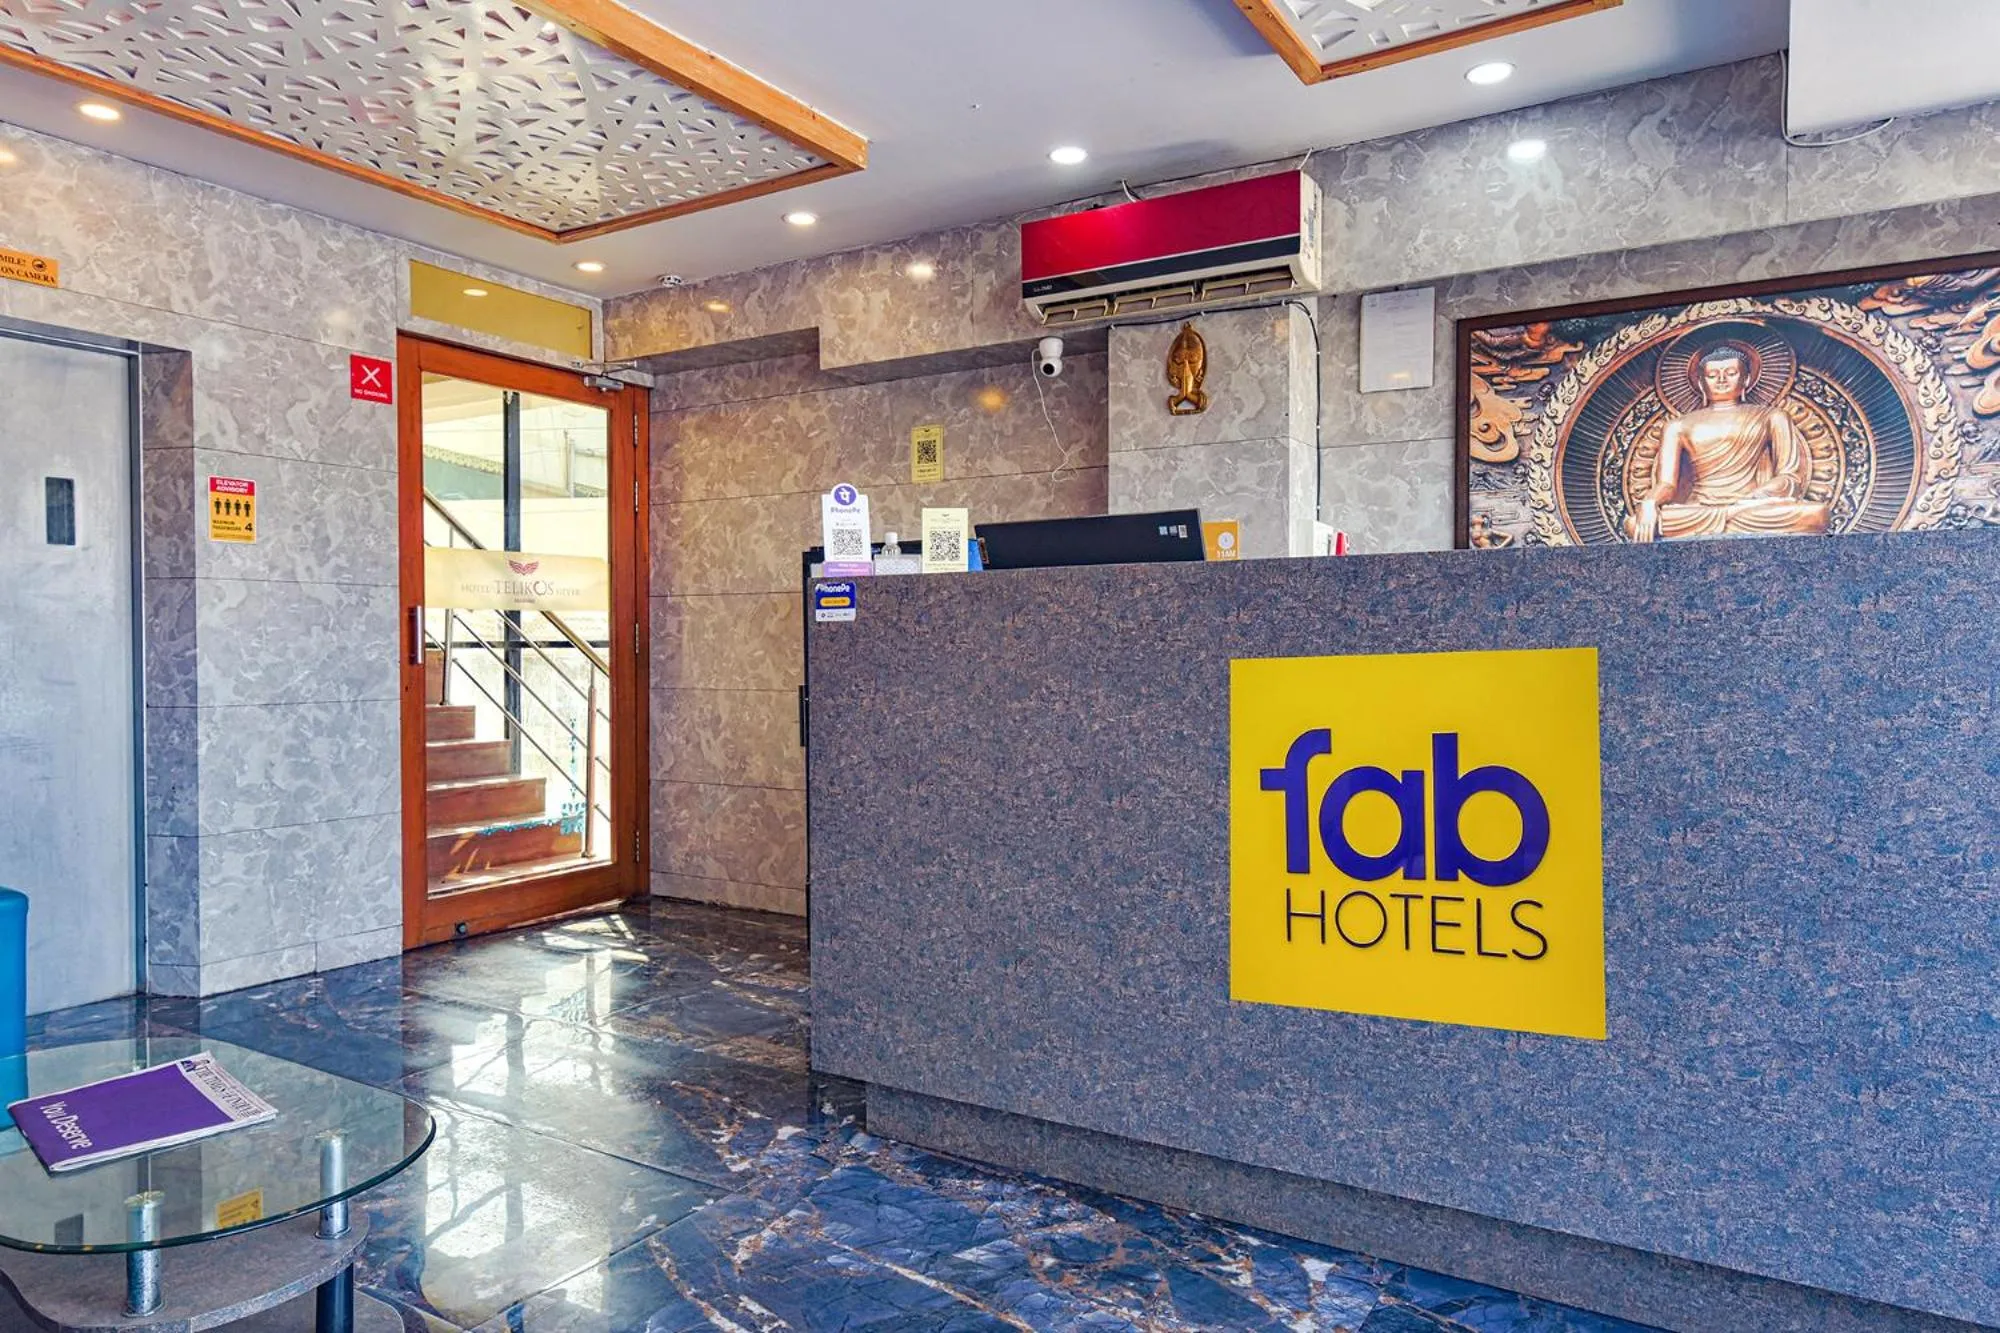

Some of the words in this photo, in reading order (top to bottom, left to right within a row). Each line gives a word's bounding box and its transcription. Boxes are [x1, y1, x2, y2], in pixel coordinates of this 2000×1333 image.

[1, 266, 14, 275] ON
[16, 269, 55, 284] CAMERA
[216, 479, 248, 488] ELEVATOR
[216, 486, 248, 494] ADVISORY
[245, 523, 253, 531] 4
[461, 583, 490, 593] HOTEL
[495, 579, 555, 596] TELIKOS
[1260, 728, 1550, 887] fab
[1286, 888, 1547, 960] HOTELS
[40, 1101, 67, 1118] You
[51, 1115, 92, 1149] Deserve
